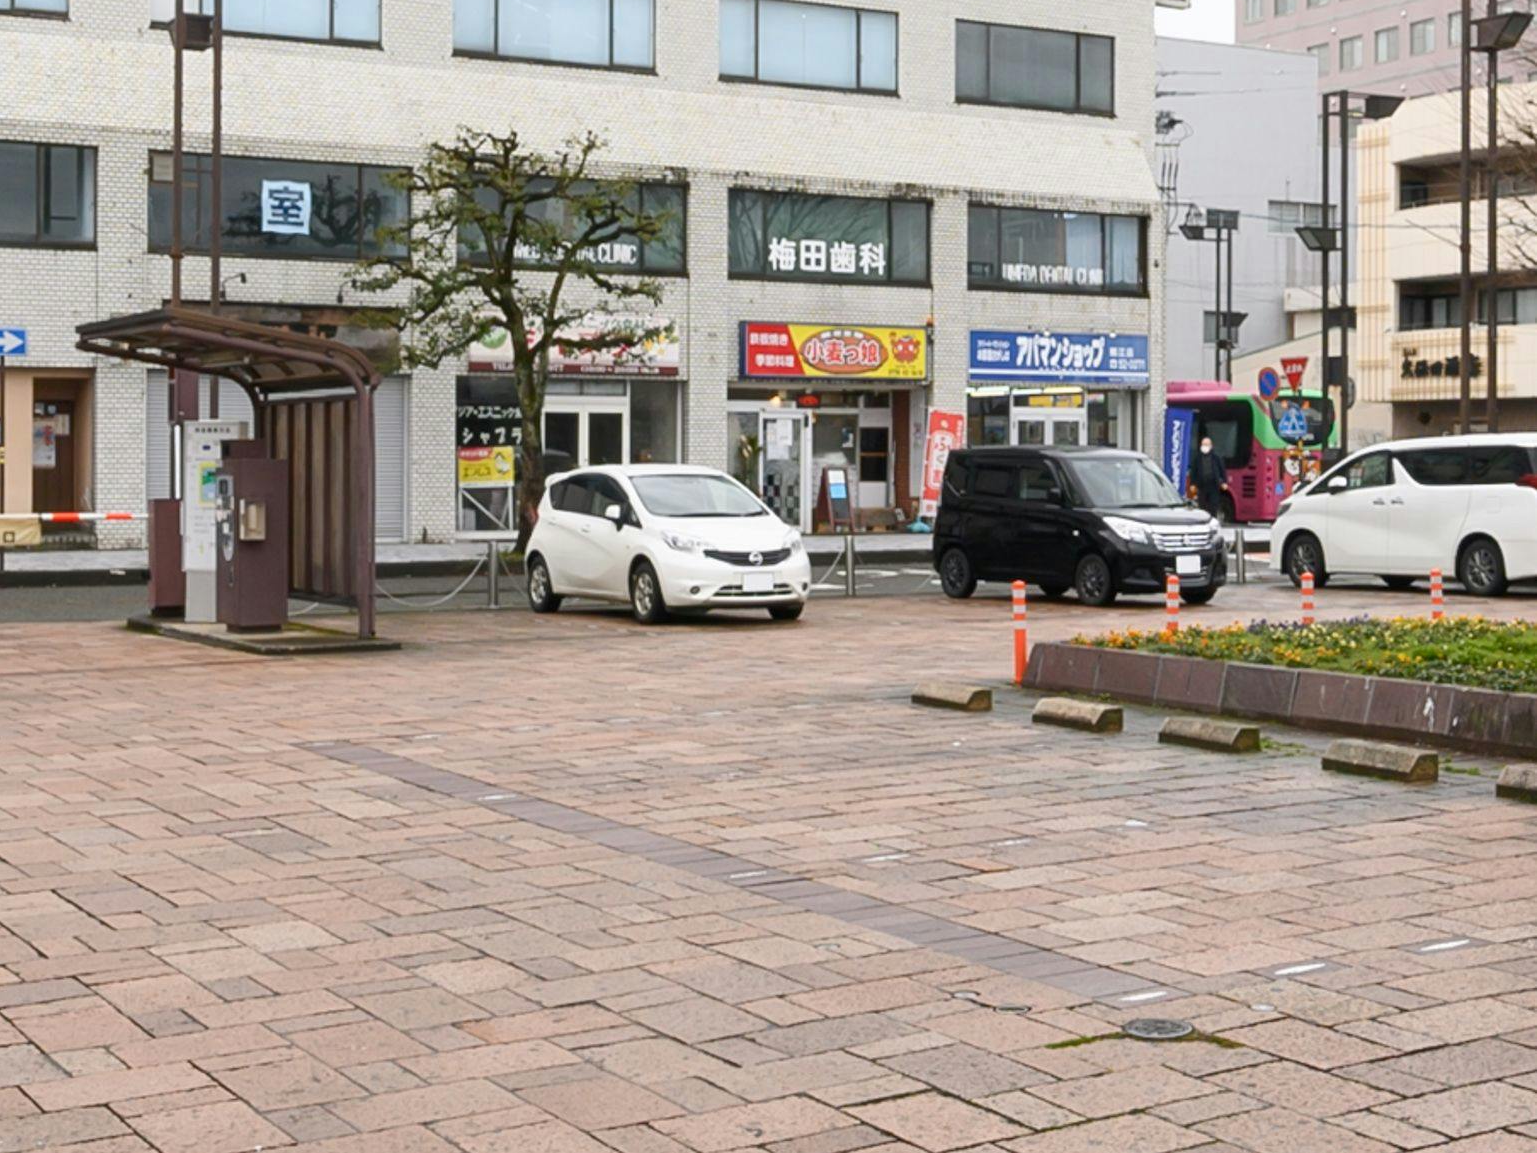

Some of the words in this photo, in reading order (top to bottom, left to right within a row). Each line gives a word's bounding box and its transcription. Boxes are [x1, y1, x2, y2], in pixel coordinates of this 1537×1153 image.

[267, 185, 305, 227] 室
[767, 237, 887, 276] 梅田歯科
[803, 338, 881, 367] 小麦っ娘
[1016, 334, 1106, 368] アパマンショップ
